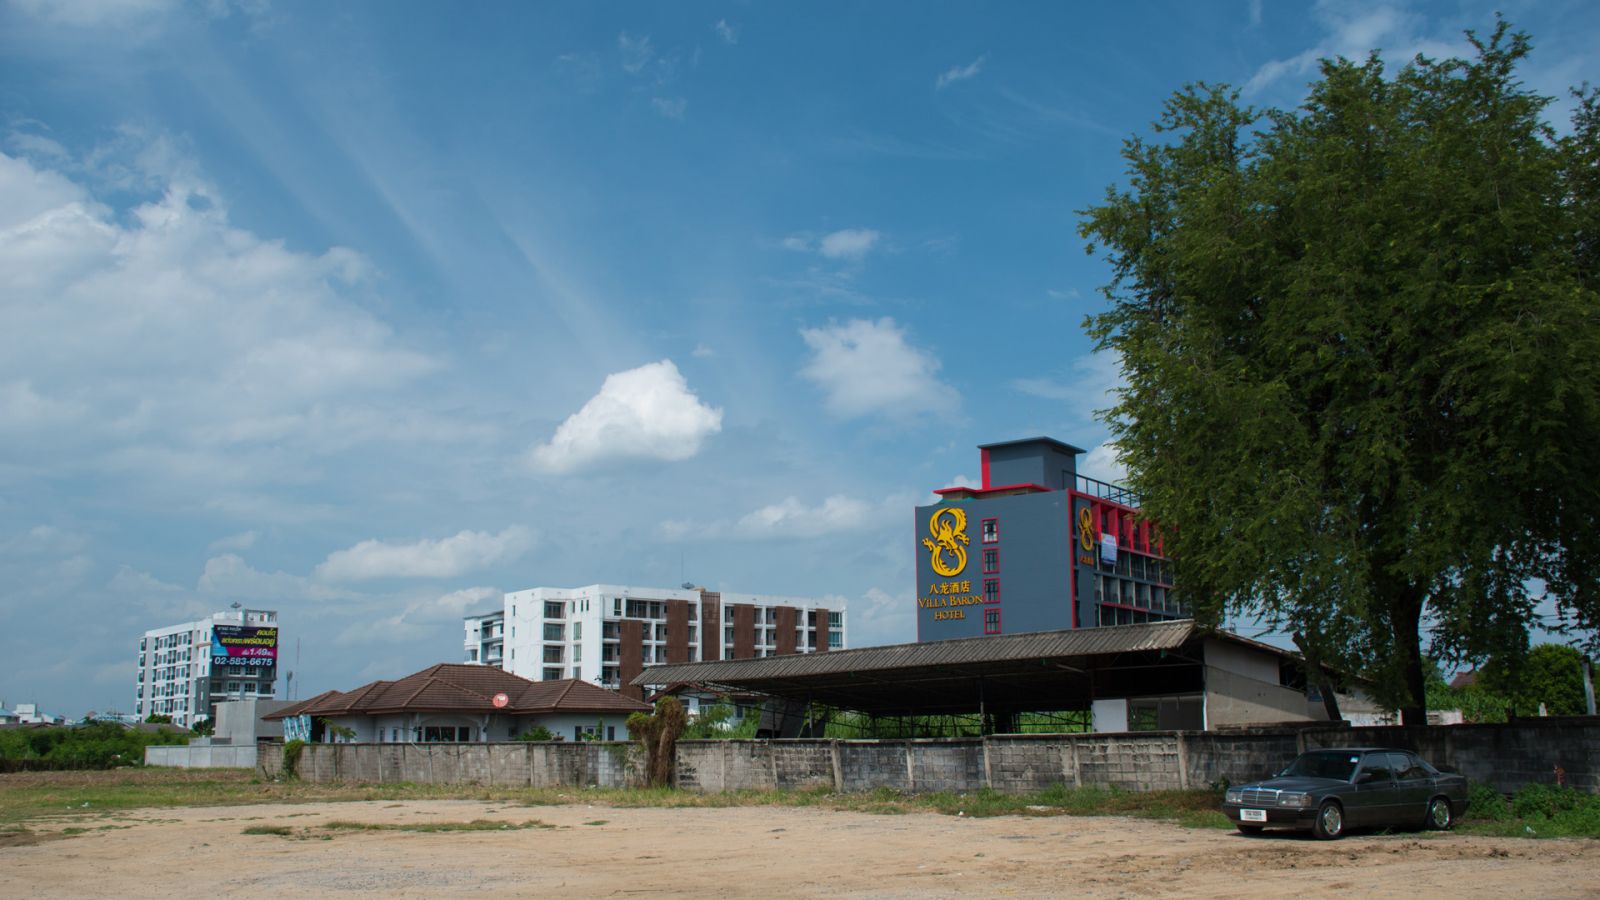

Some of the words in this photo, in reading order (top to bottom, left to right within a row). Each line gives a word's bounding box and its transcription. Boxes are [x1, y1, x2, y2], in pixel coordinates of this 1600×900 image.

[929, 581, 970, 594] 八龙酒店
[918, 597, 946, 608] VILLA
[949, 594, 983, 606] BARON
[935, 609, 965, 620] HOTEL
[214, 657, 273, 666] 02-583-6675
